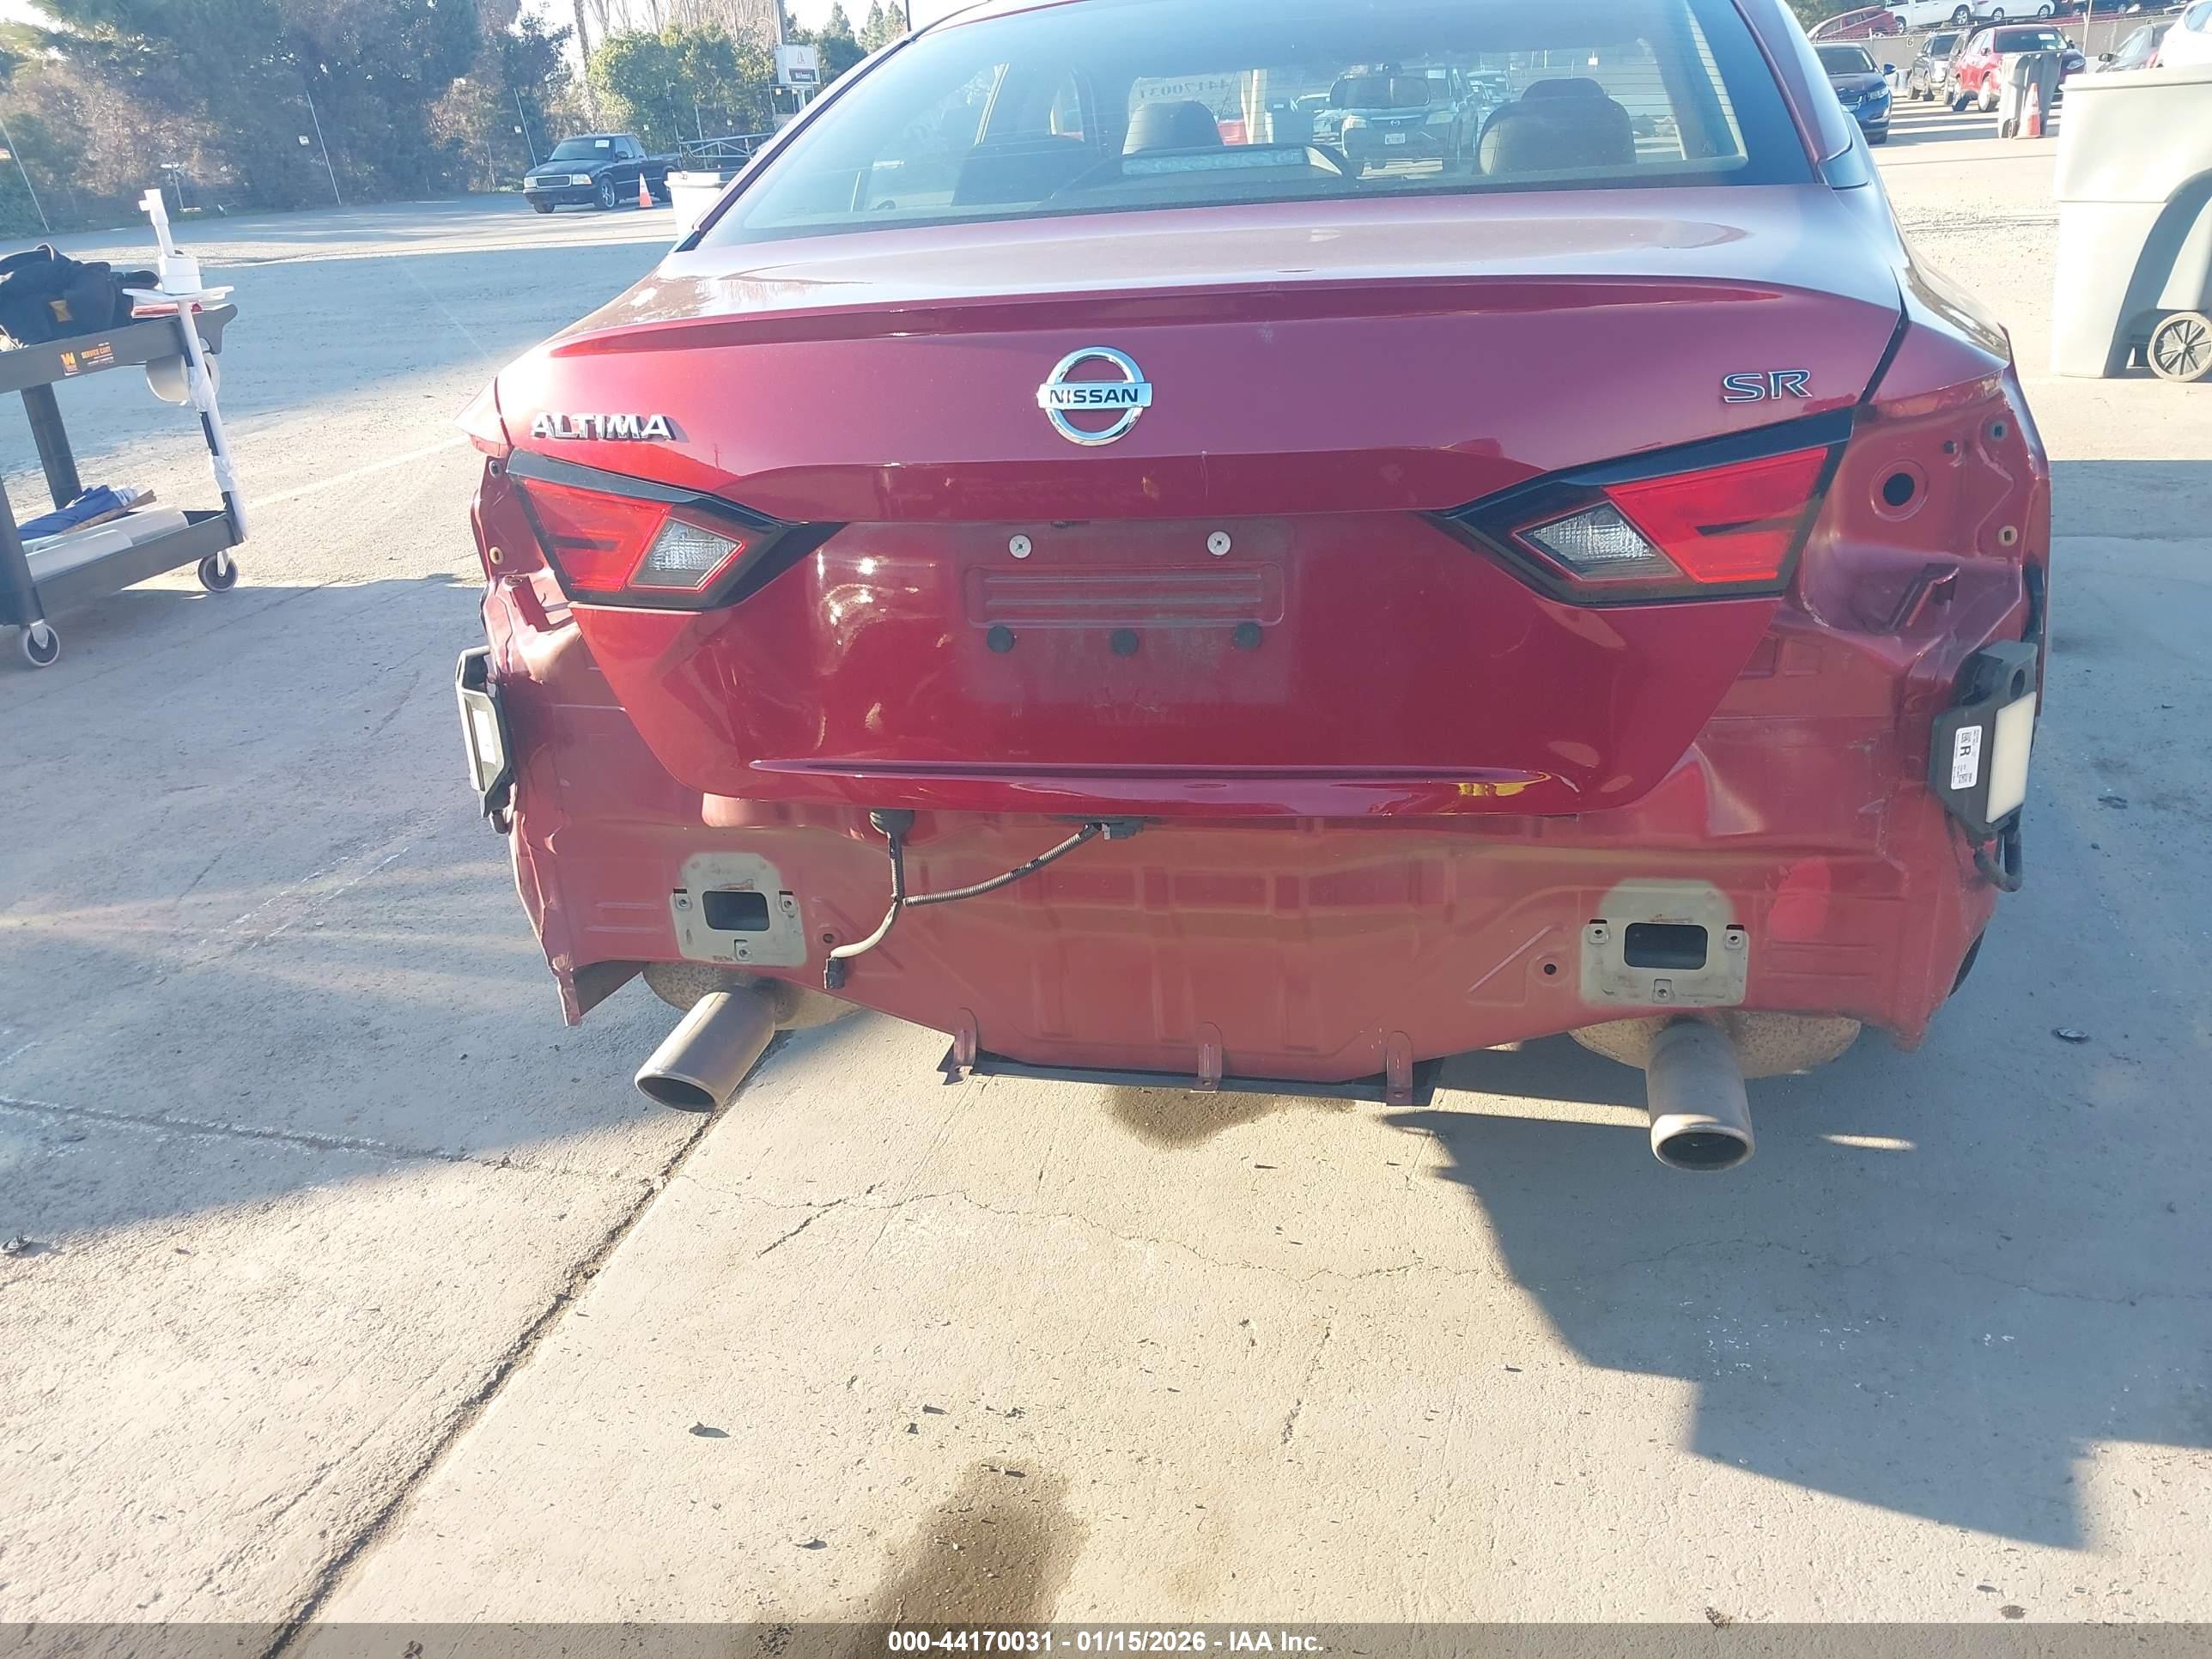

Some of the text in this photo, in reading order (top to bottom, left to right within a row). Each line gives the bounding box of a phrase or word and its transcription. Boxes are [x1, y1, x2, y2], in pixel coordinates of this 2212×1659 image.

[1050, 388, 1138, 404] NISSAN
[1723, 369, 1813, 403] SR
[531, 412, 678, 441] ALTIMA
[1960, 745, 1972, 757] R
